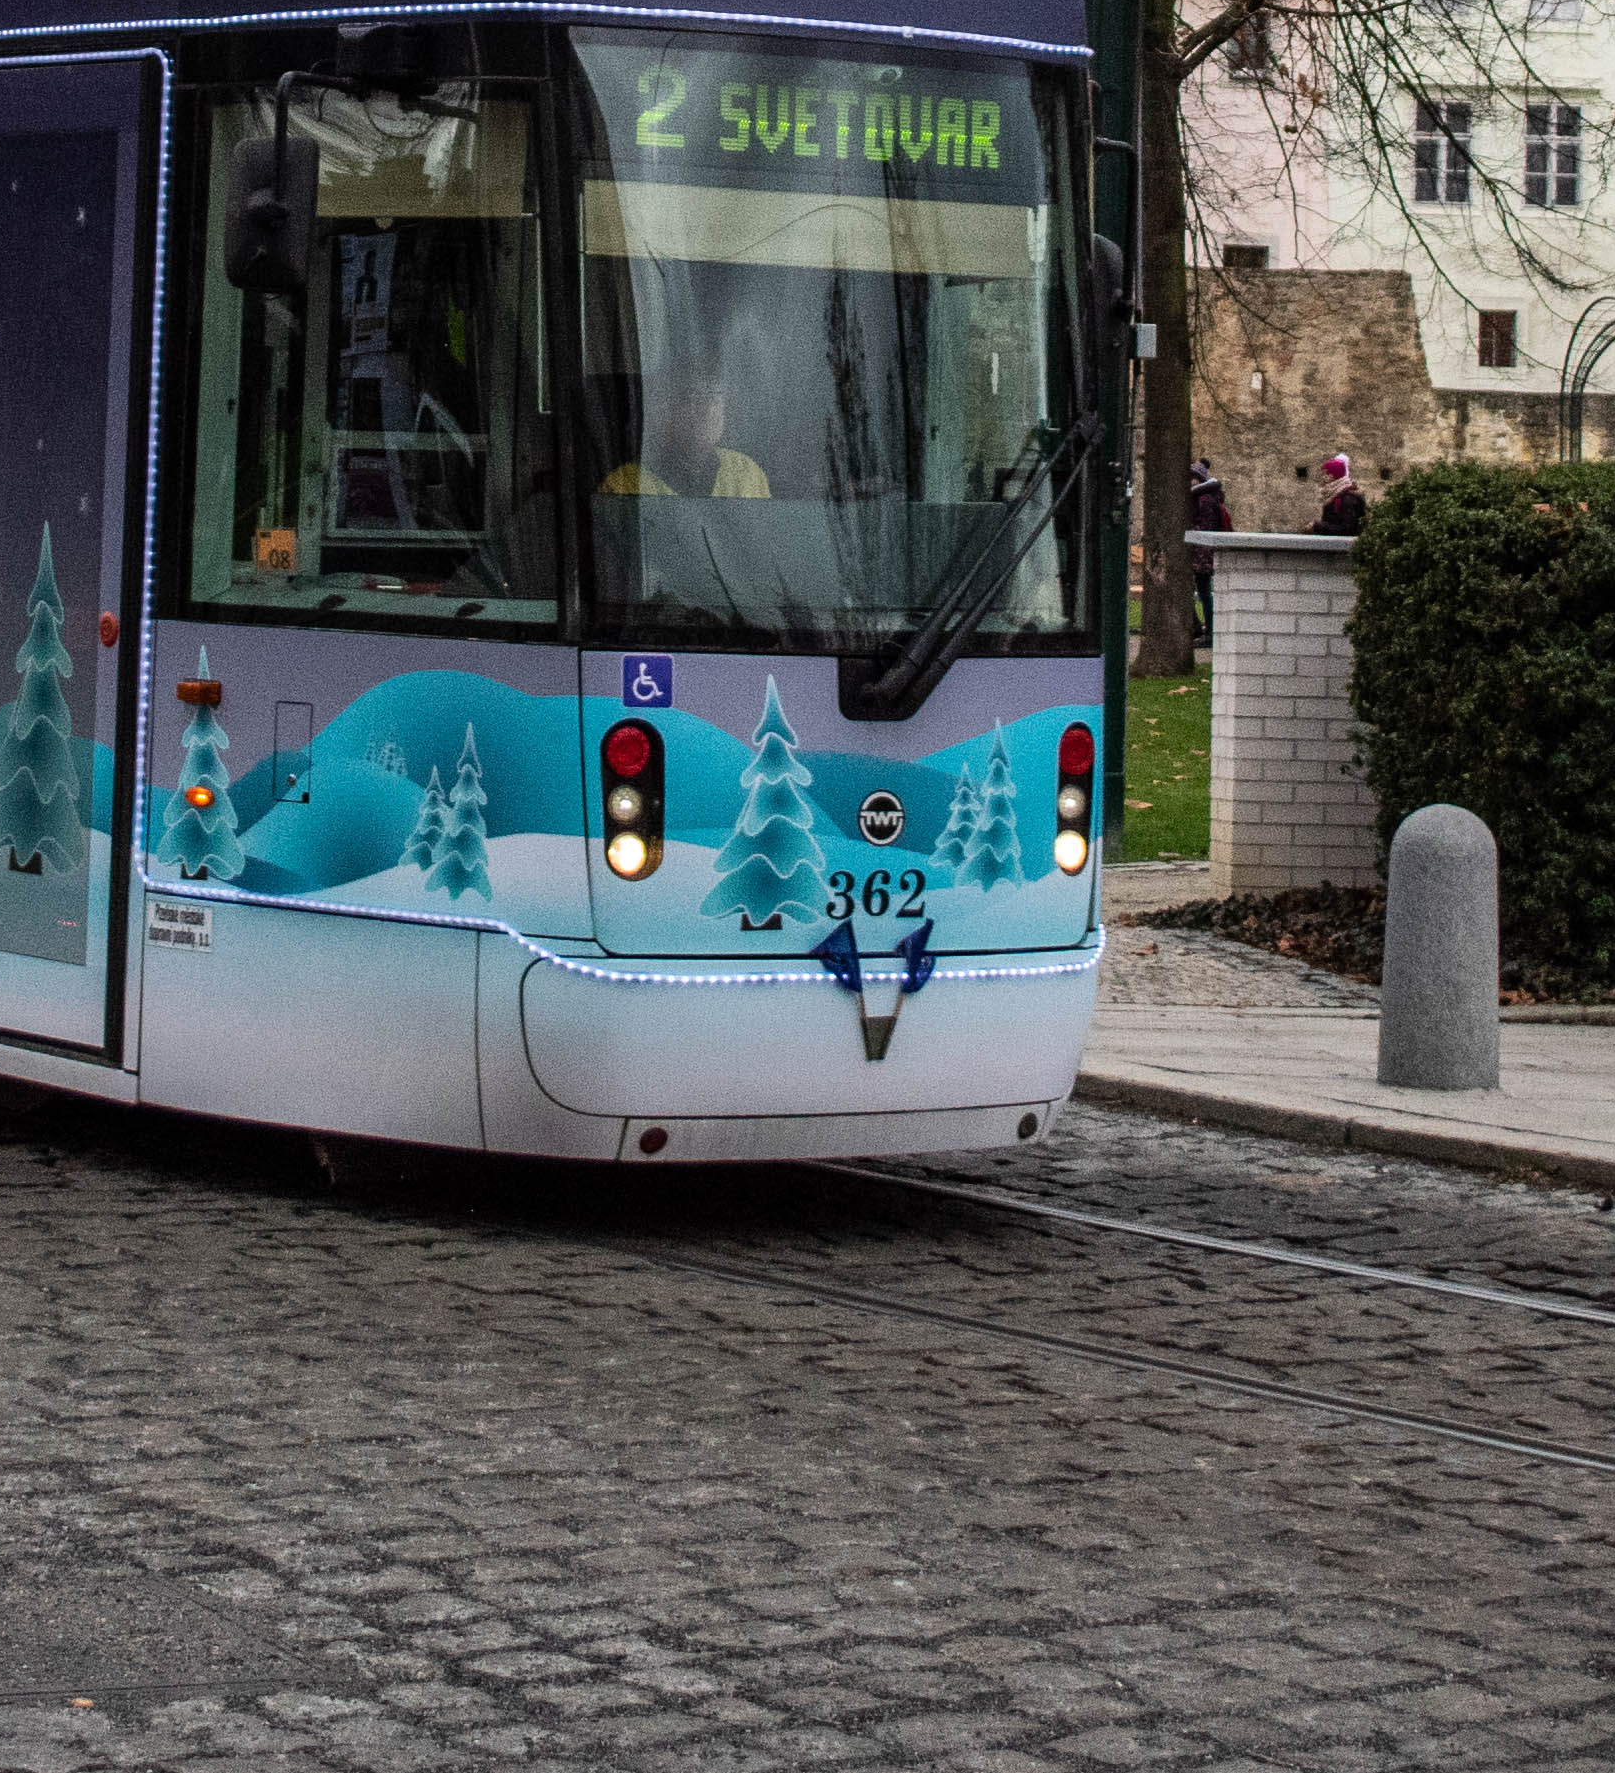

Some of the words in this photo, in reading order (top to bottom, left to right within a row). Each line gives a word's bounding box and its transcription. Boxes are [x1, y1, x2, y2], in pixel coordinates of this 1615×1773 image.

[636, 64, 685, 148] 2
[860, 810, 904, 826] TWT
[826, 869, 926, 920] 362
